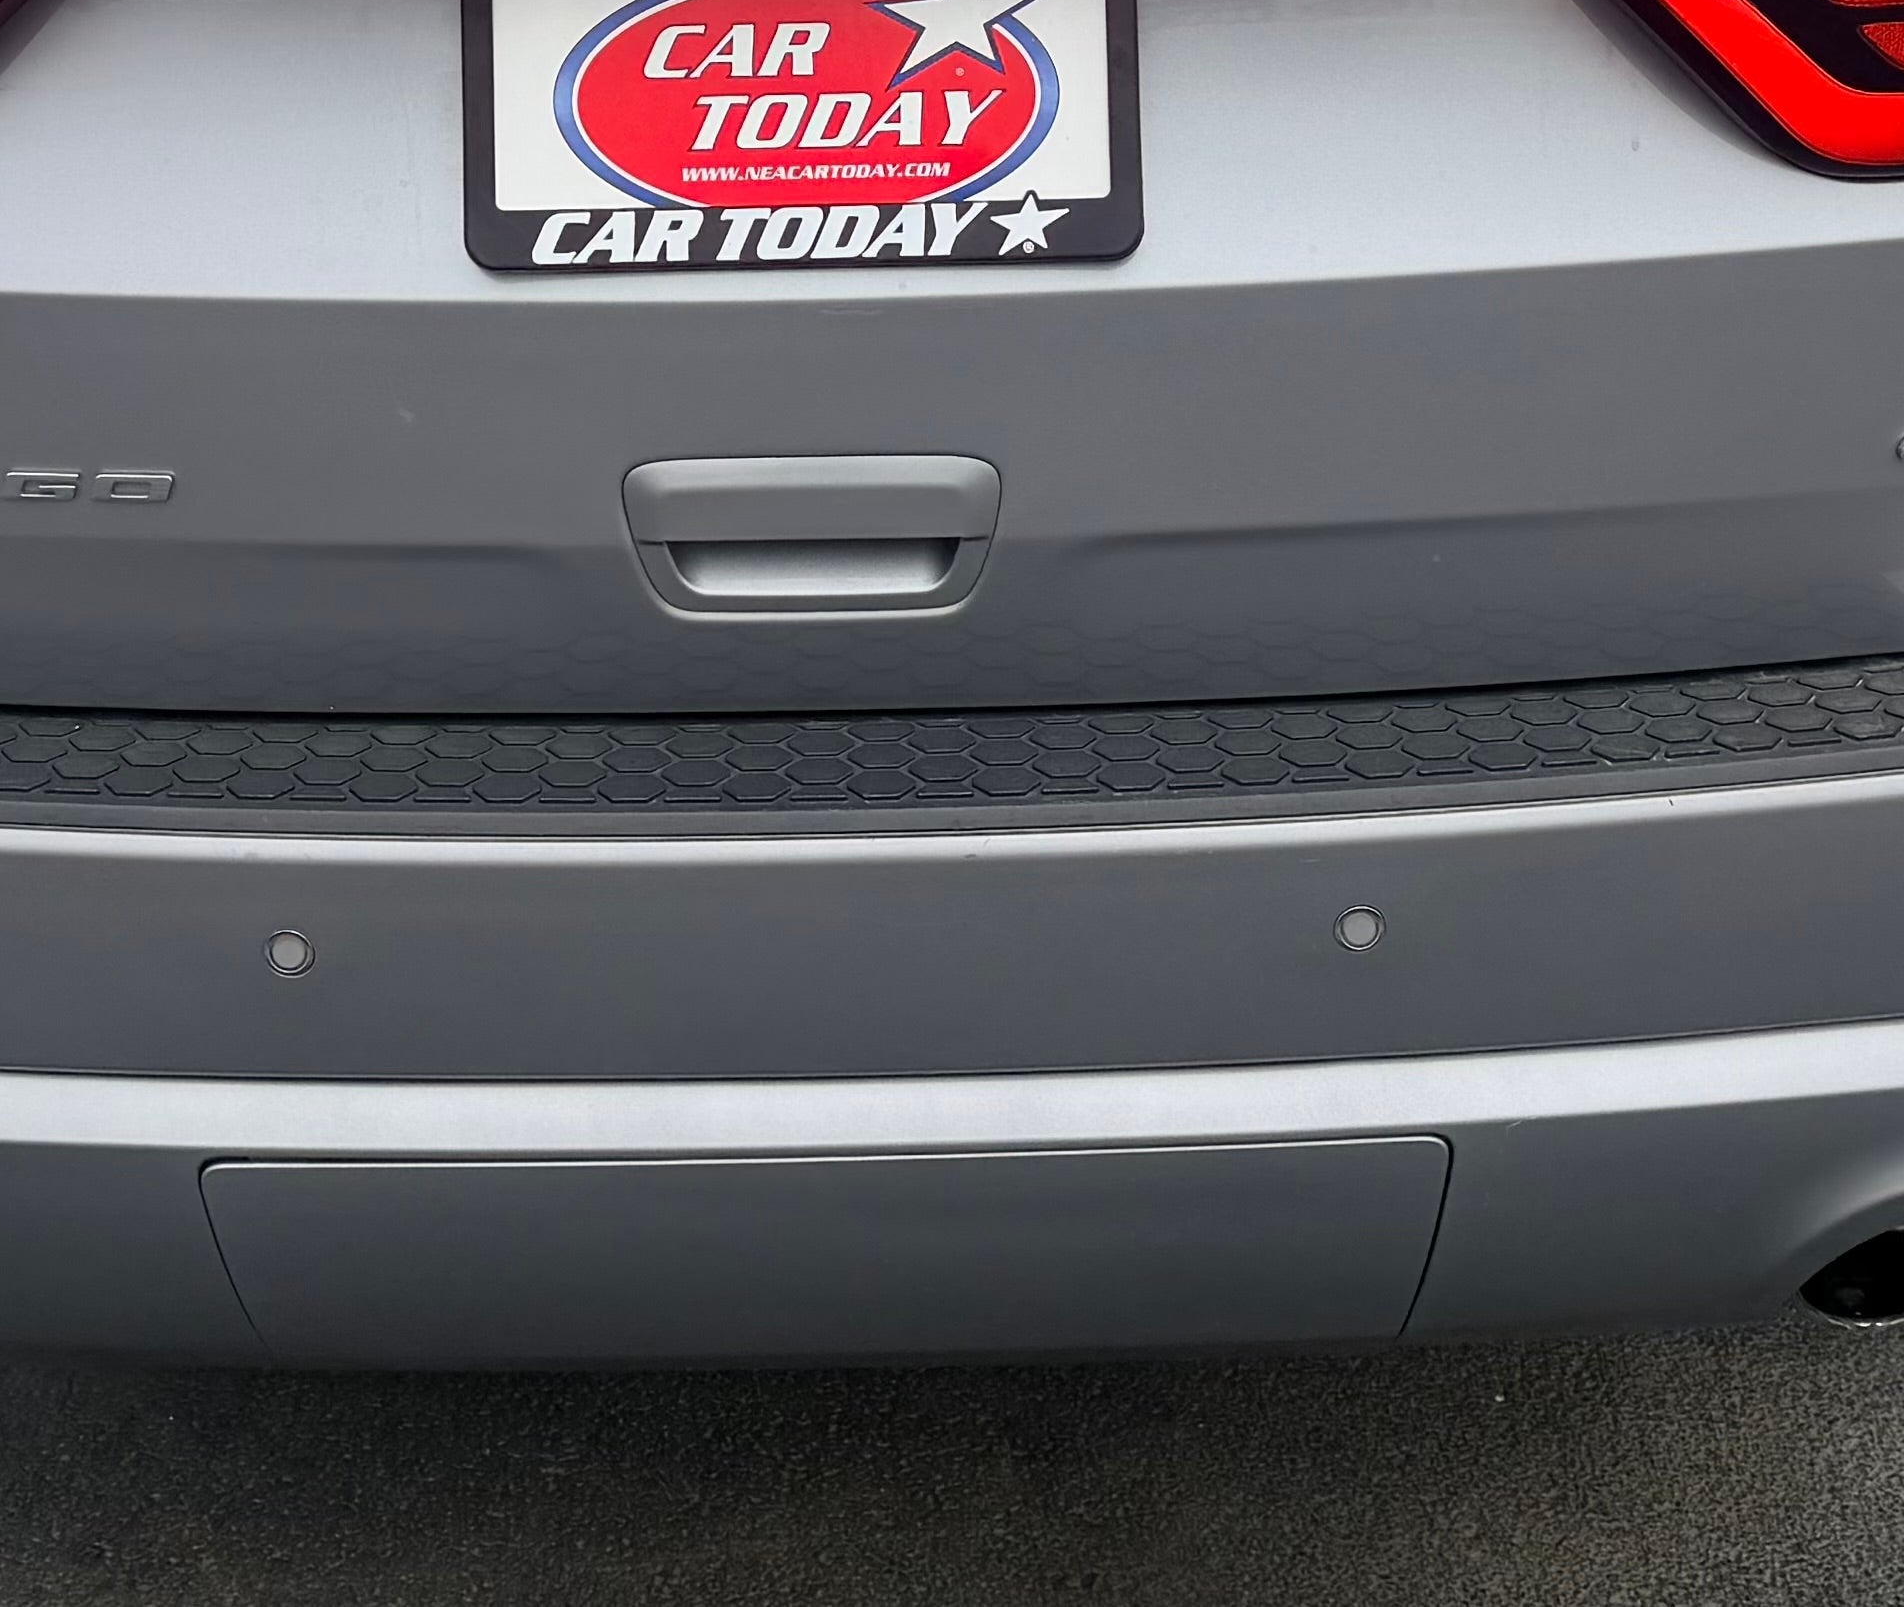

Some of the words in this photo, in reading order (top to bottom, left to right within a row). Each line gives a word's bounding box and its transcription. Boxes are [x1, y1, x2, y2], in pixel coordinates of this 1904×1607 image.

[642, 21, 831, 80] CAR
[688, 89, 1006, 152] TODAY
[680, 161, 951, 182] WWW.NEACARTODAY.COM
[531, 210, 704, 265] CAR
[715, 202, 988, 262] TODAY
